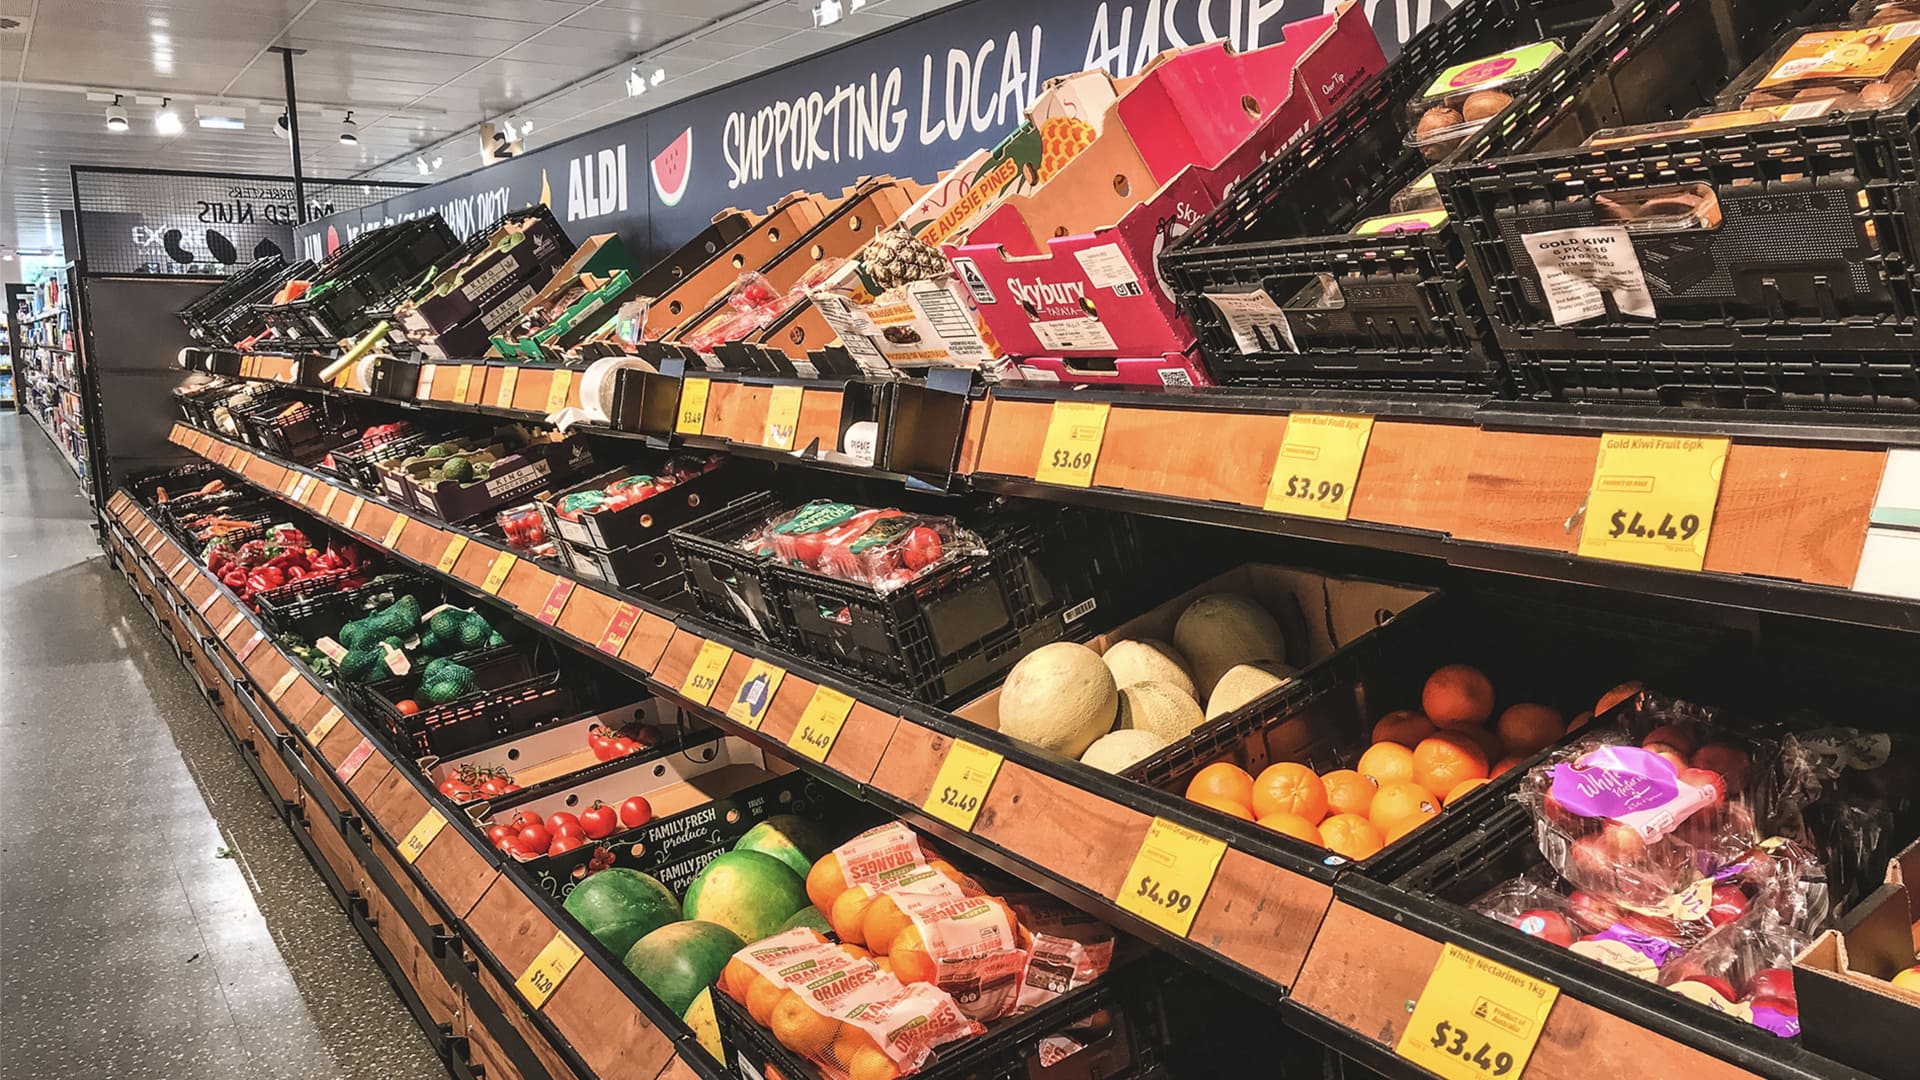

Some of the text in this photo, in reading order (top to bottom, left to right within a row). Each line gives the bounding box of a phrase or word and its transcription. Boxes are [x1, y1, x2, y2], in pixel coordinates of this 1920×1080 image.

[1331, 72, 1345, 87] Tip
[723, 67, 907, 189] SUPPORTING
[920, 24, 1042, 145] LOCAL
[493, 132, 513, 158] 2
[567, 144, 628, 222] ALDI
[939, 194, 982, 236] AUSSIE
[981, 163, 1017, 198] PINES
[1176, 202, 1205, 221] Sky
[1539, 237, 1616, 250] GOLD KIWI
[470, 270, 494, 288] KING
[1007, 276, 1085, 312] Skybury
[1047, 307, 1076, 316] PAPAYA
[684, 412, 701, 424] $3.49
[1312, 417, 1327, 425] Kiwi
[1328, 419, 1345, 427] Fruit
[1606, 439, 1704, 452] Gold Kiwi Fruit 6pk
[1052, 449, 1092, 469] $3.69
[495, 470, 524, 485] KING
[496, 477, 529, 493] AVOCADO
[1285, 475, 1344, 503] $3.99
[1608, 509, 1700, 541] $4.49
[691, 674, 715, 691] $3.79
[800, 725, 830, 749] $4.49
[940, 786, 978, 813] $2.49
[649, 807, 717, 842] FAMILY FRESH
[662, 827, 708, 855] produce
[659, 859, 694, 883] FAMILY
[850, 851, 913, 879] ORANGES
[1136, 876, 1191, 914] $4.99
[530, 969, 554, 994] $1.29
[812, 968, 876, 1001] ORANGES
[1449, 949, 1546, 999] White Nectarines 1kg
[1491, 1015, 1521, 1033] Australia
[1492, 1007, 1518, 1023] Product
[894, 1007, 957, 1053] ORANGES
[1430, 1019, 1514, 1077] $3.49
